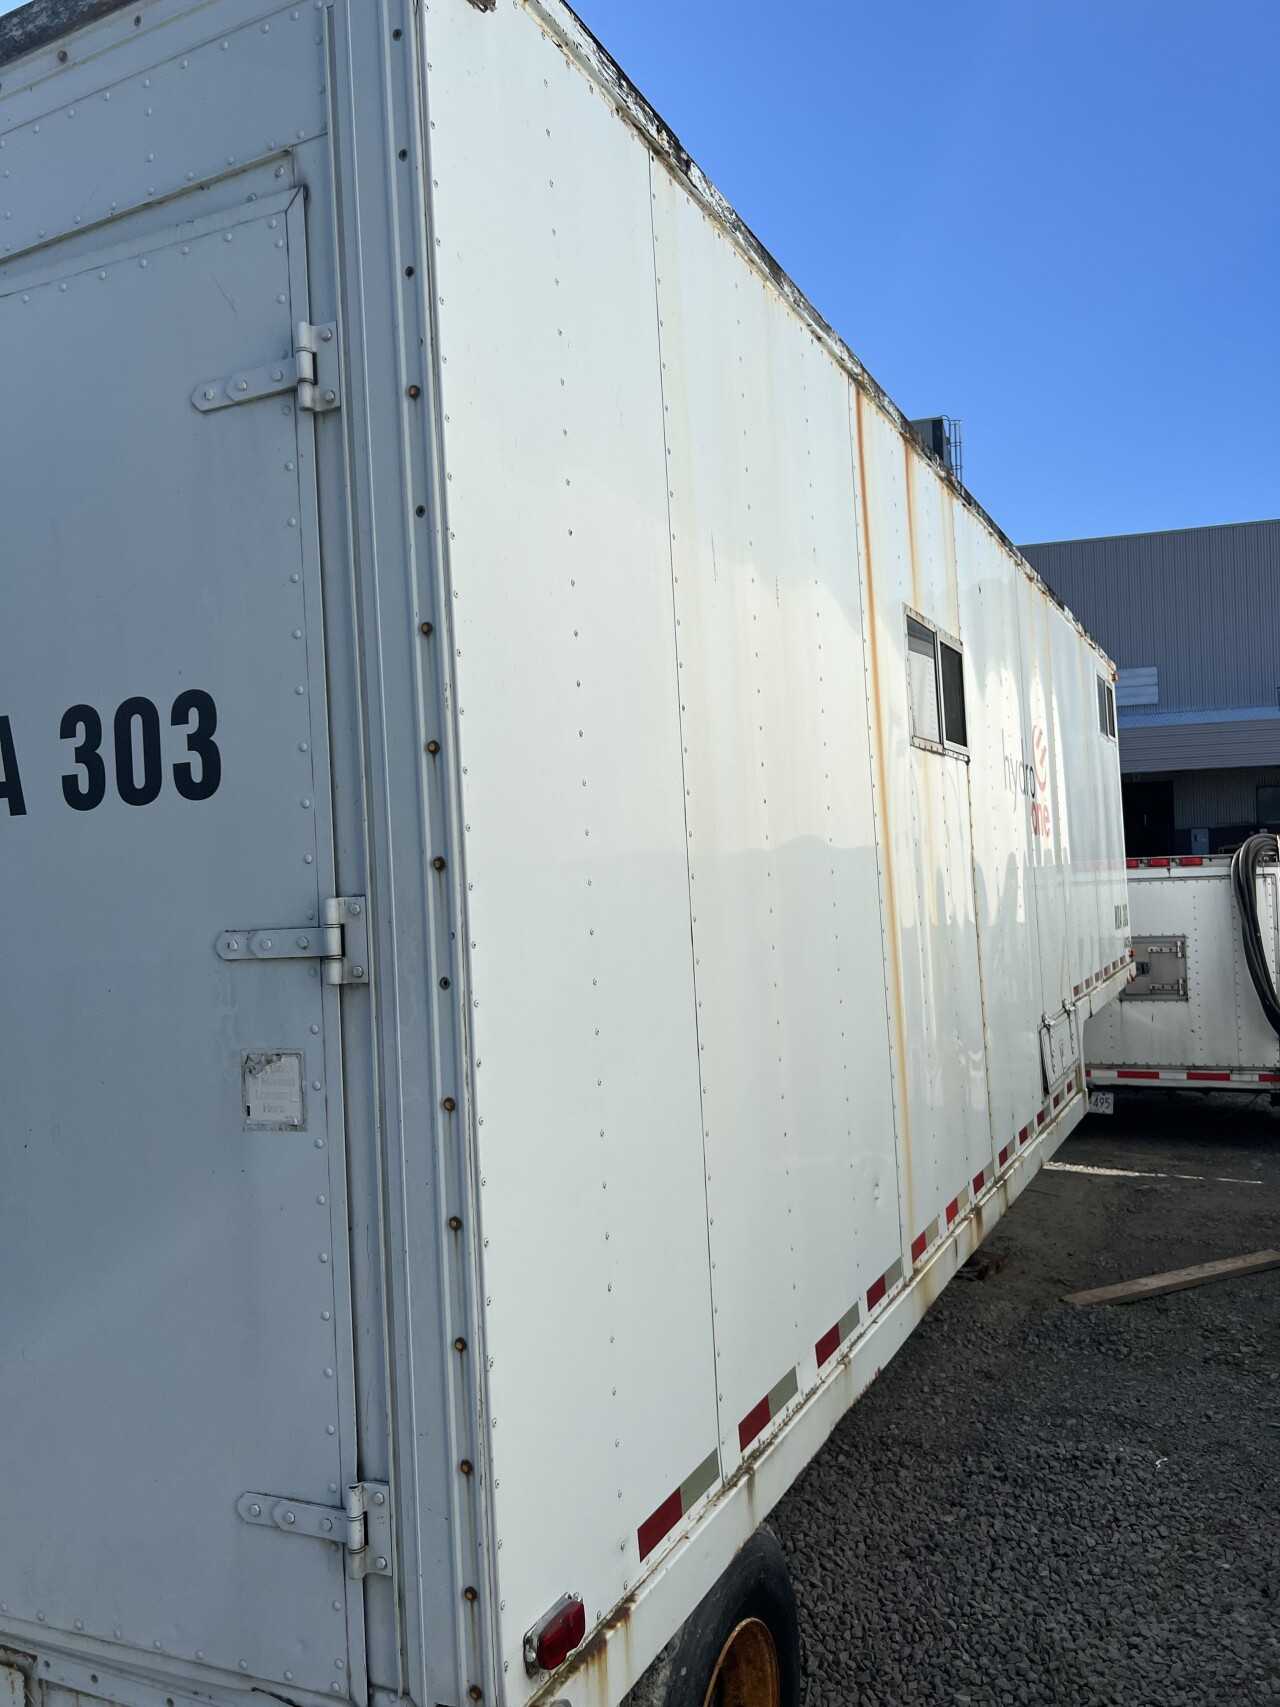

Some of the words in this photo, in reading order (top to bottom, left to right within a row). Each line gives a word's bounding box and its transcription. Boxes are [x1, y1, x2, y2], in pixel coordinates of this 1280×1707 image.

[60, 689, 221, 811] 303
[1001, 728, 1036, 814] hydro
[1031, 801, 1051, 838] one
